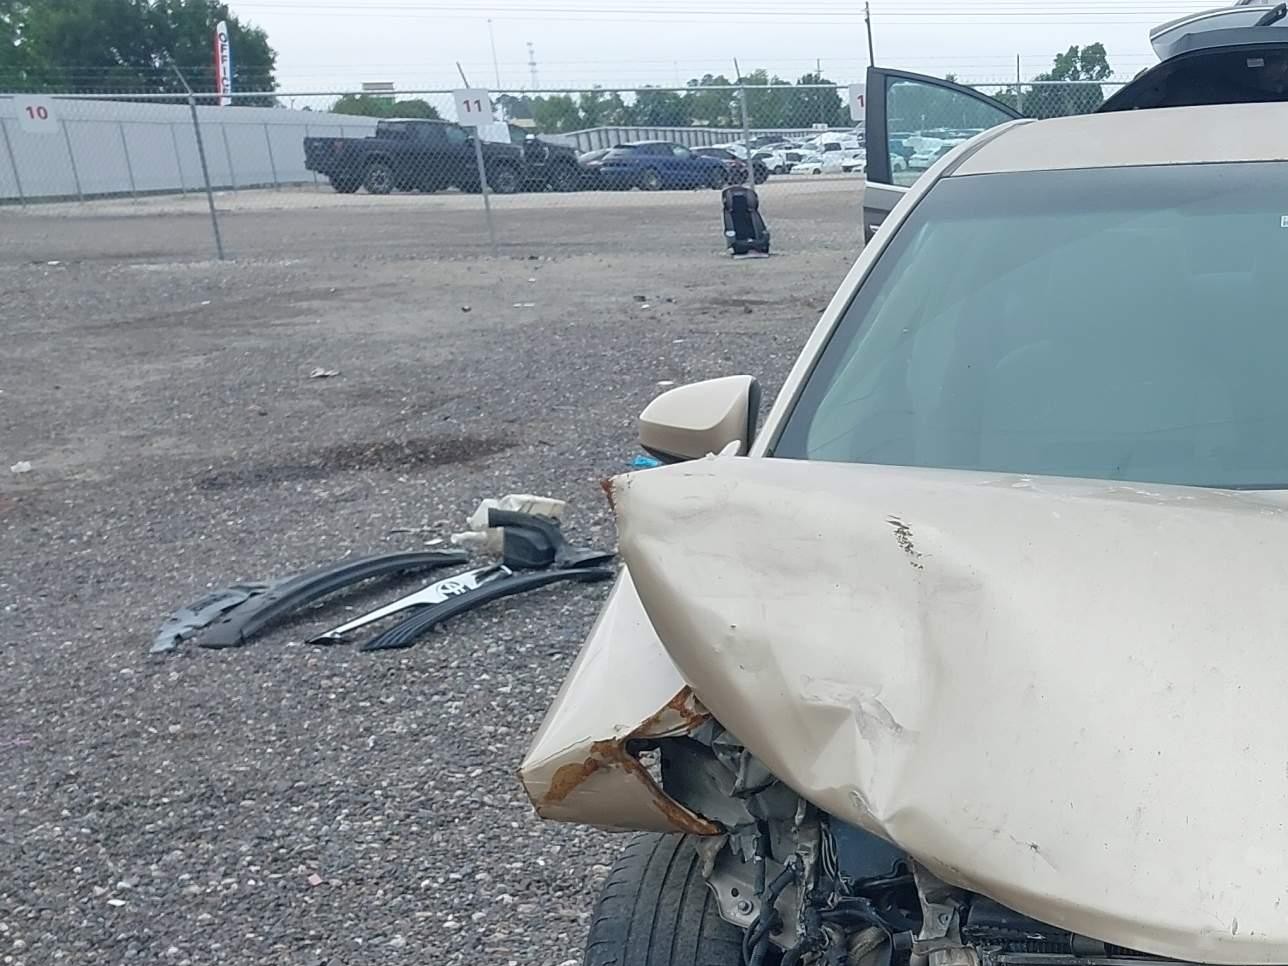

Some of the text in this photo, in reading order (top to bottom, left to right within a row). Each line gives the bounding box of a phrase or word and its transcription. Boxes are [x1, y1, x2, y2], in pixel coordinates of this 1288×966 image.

[463, 99, 482, 113] 11
[857, 94, 865, 108] 1
[25, 105, 48, 120] 10
